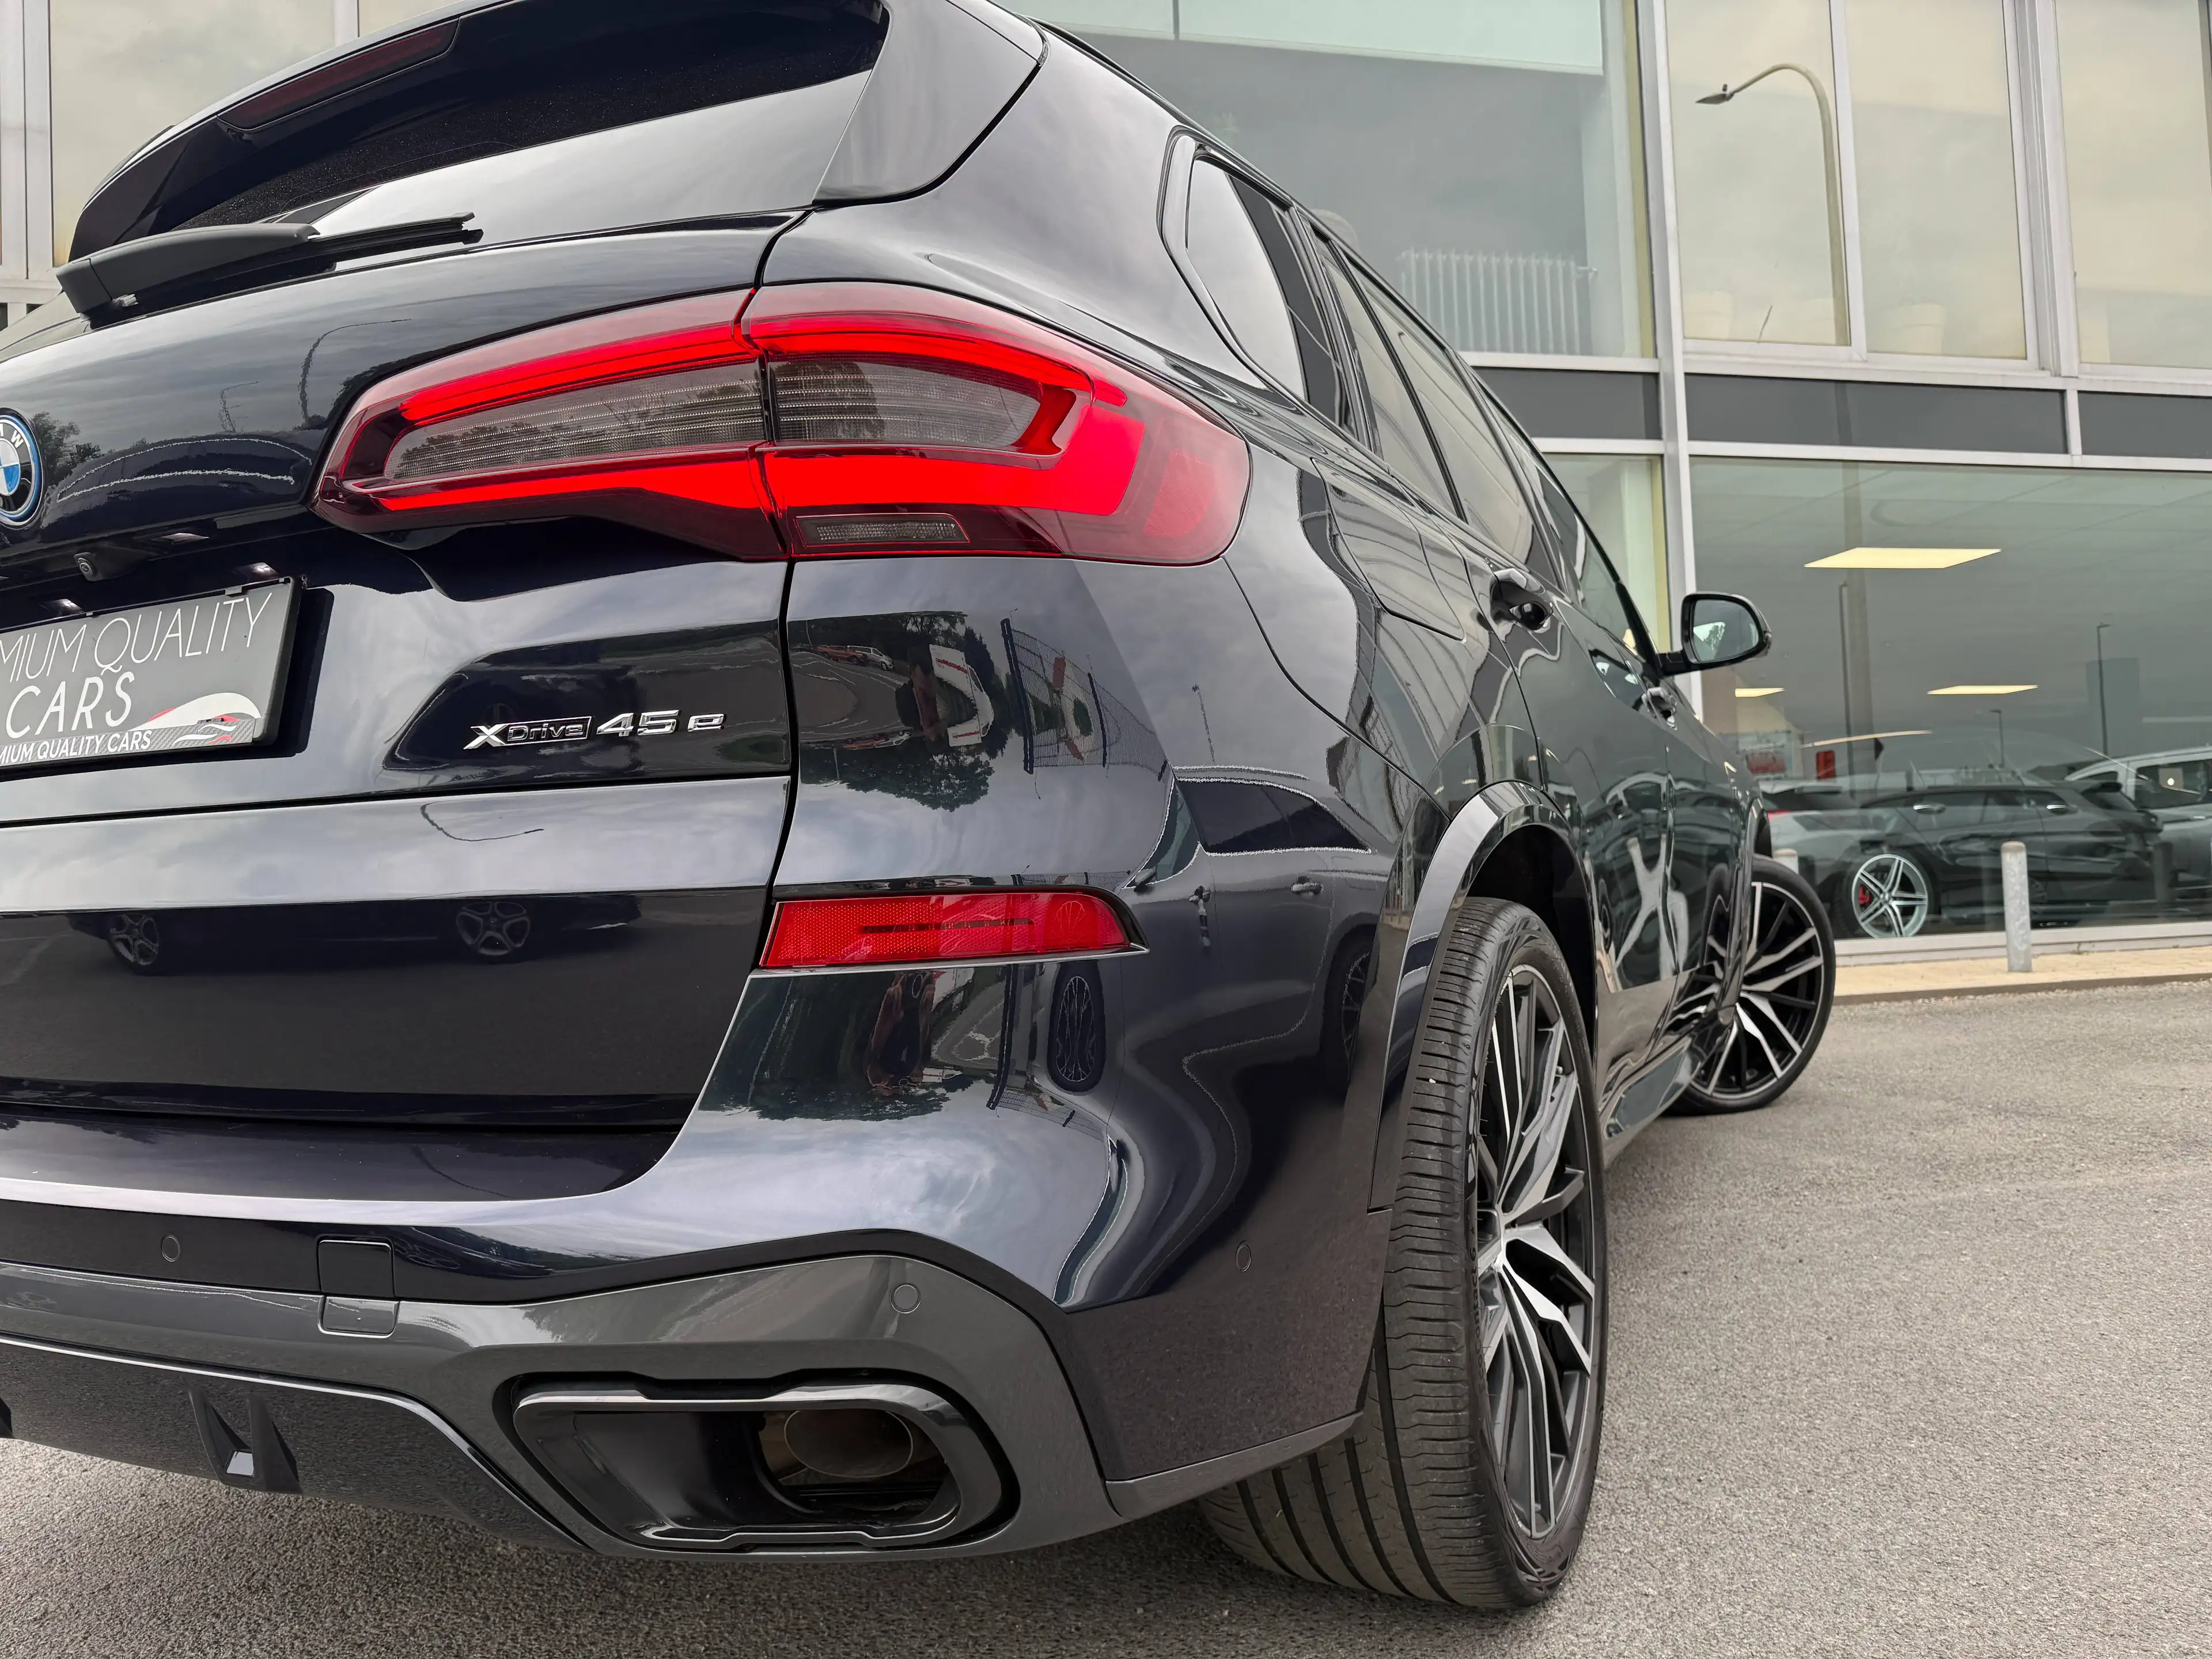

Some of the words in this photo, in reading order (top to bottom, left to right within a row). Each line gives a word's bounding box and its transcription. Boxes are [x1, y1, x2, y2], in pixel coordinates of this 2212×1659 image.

[94, 593, 272, 673] QUALITY
[6, 671, 135, 738] CARS
[37, 734, 105, 760] QUALITY
[107, 730, 153, 752] CARS
